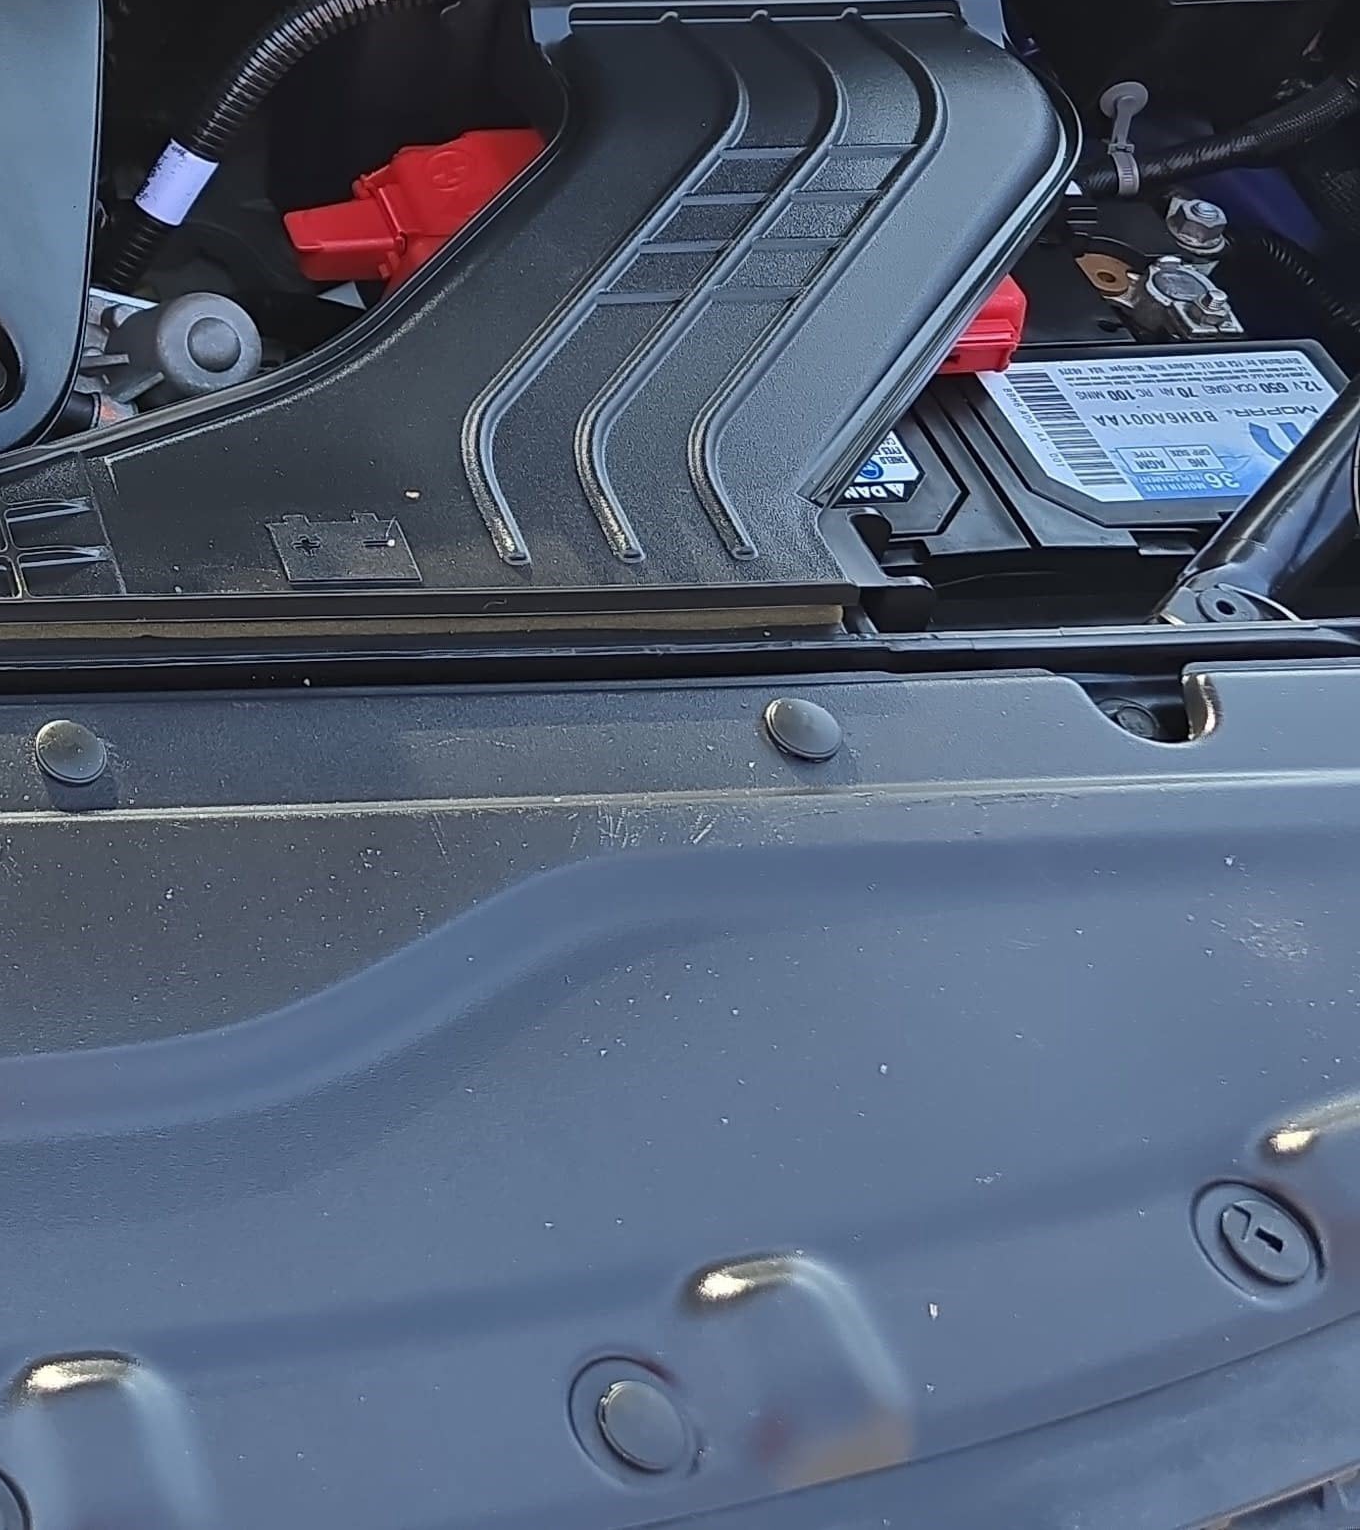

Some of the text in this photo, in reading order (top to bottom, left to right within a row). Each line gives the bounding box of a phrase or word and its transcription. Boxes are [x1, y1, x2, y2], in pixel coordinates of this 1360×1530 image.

[1178, 386, 1199, 398] 70
[1233, 383, 1258, 394] CCA
[1259, 382, 1289, 394] 650
[1075, 390, 1106, 401] MINS
[1107, 388, 1137, 401] 100
[1091, 410, 1219, 427] BBH6A001AA
[1134, 459, 1167, 469] AGM
[1203, 471, 1240, 490] 36
[843, 485, 888, 500] DAN
